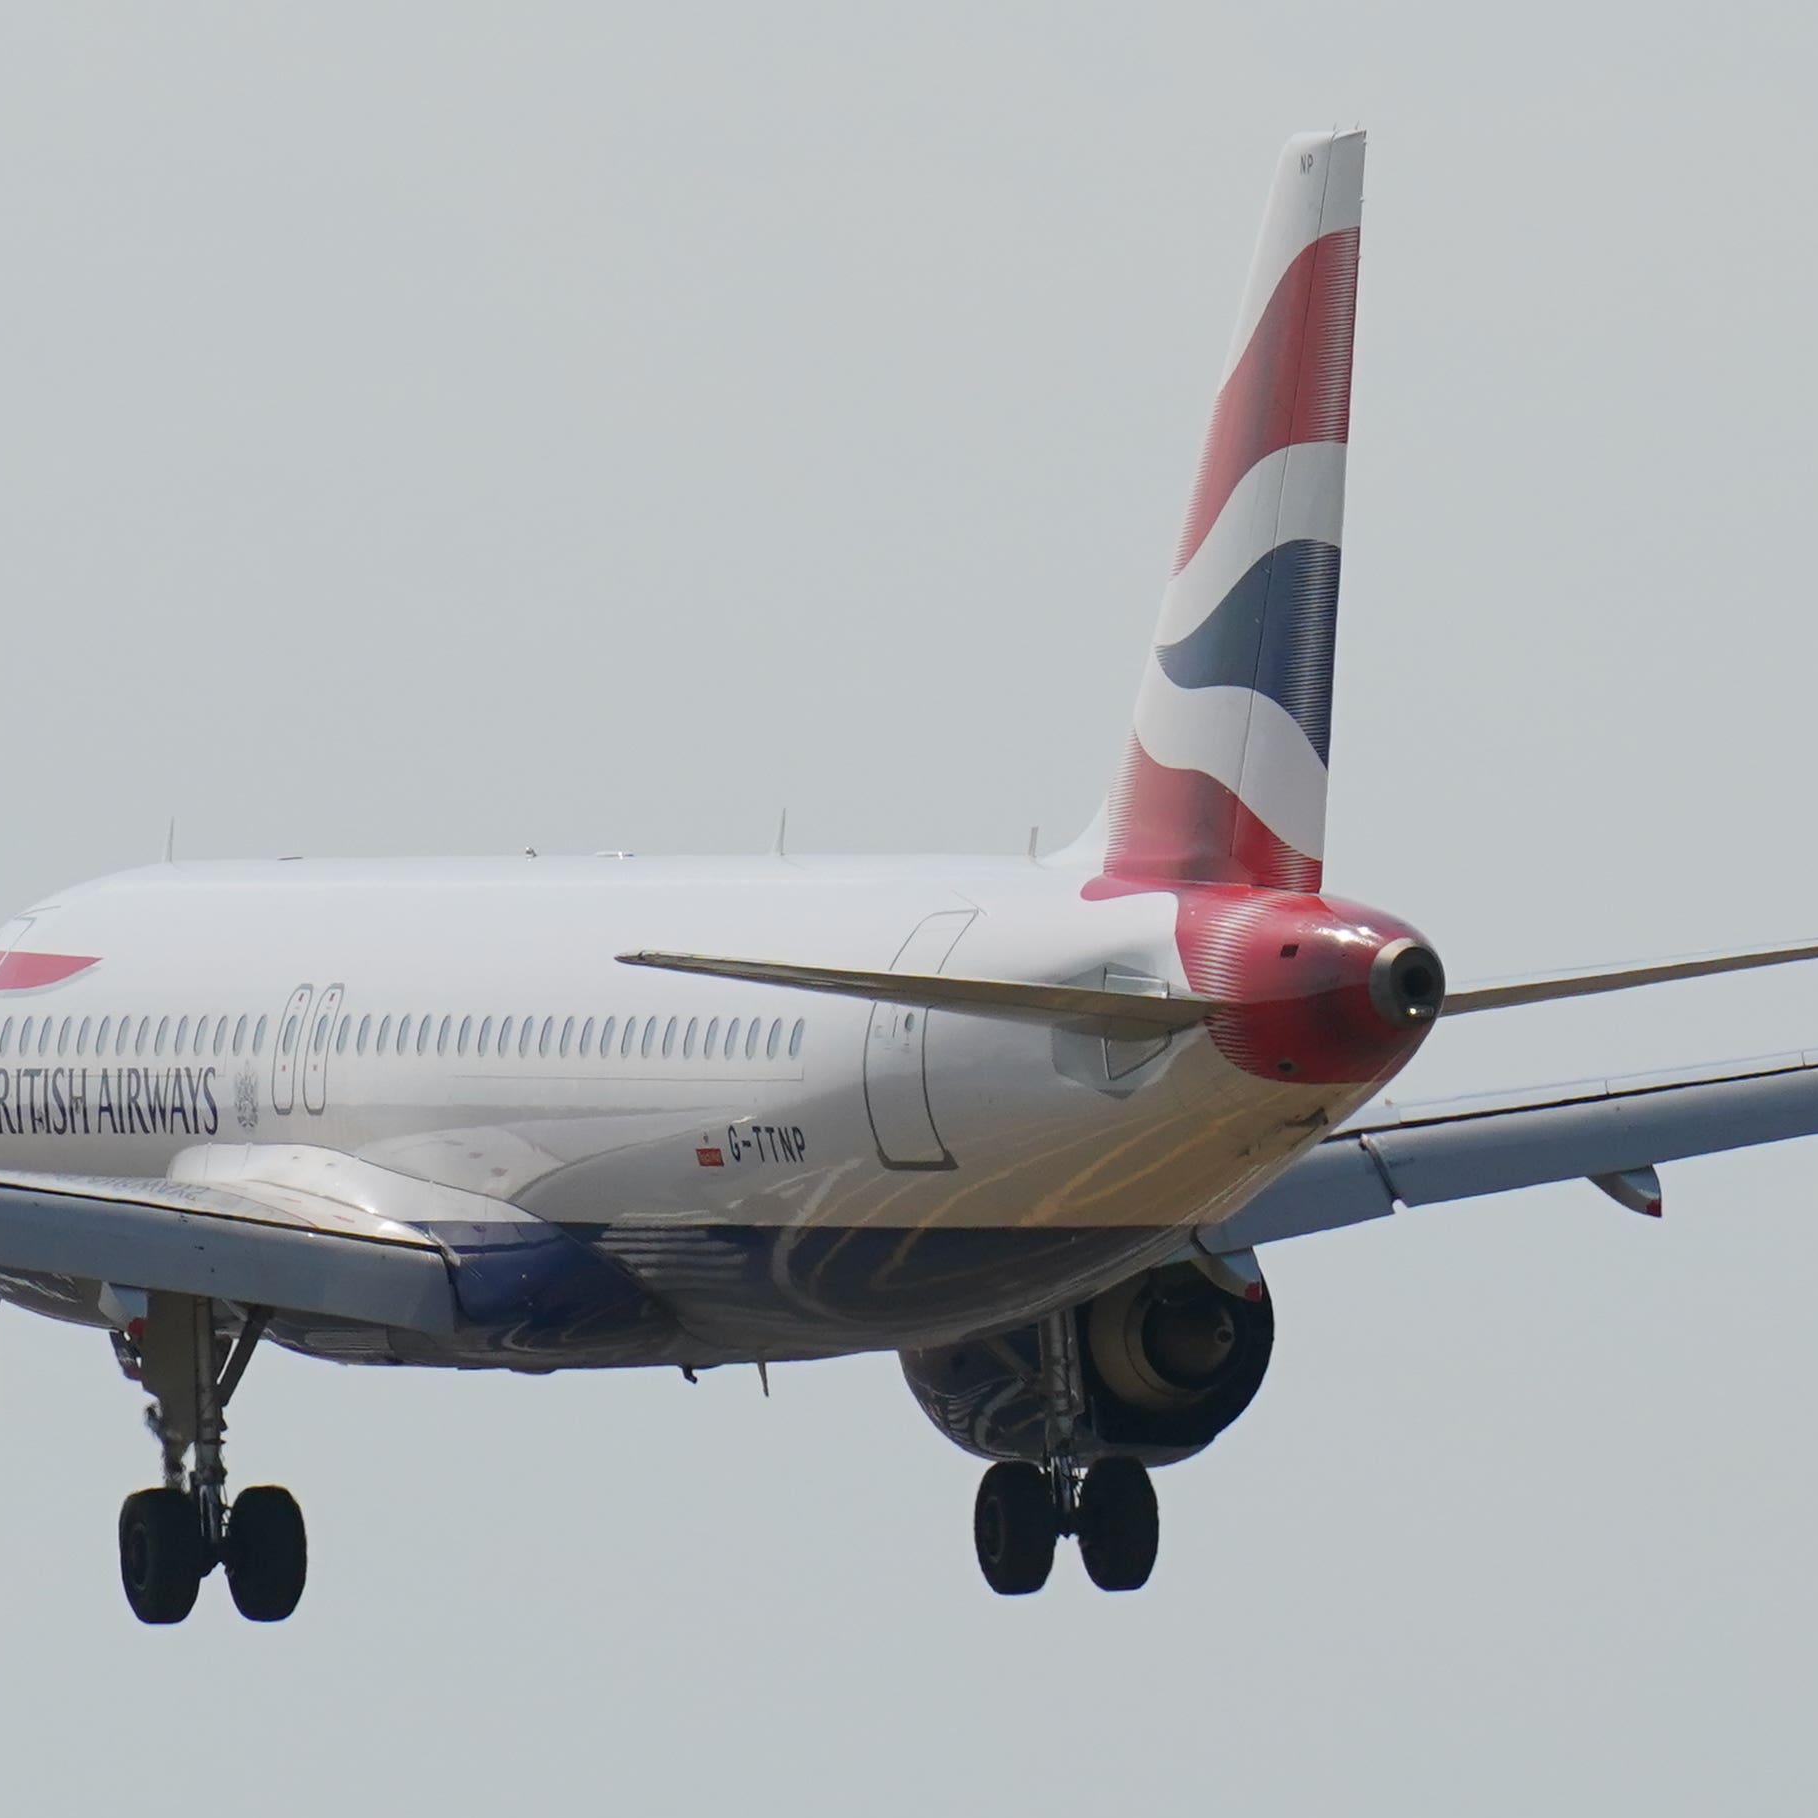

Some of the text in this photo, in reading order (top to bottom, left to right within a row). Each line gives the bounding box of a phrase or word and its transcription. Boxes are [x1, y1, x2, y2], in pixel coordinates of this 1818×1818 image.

[1299, 154, 1314, 175] NP
[97, 1066, 219, 1136] AIRWAYS
[727, 1124, 806, 1164] G-TTNP
